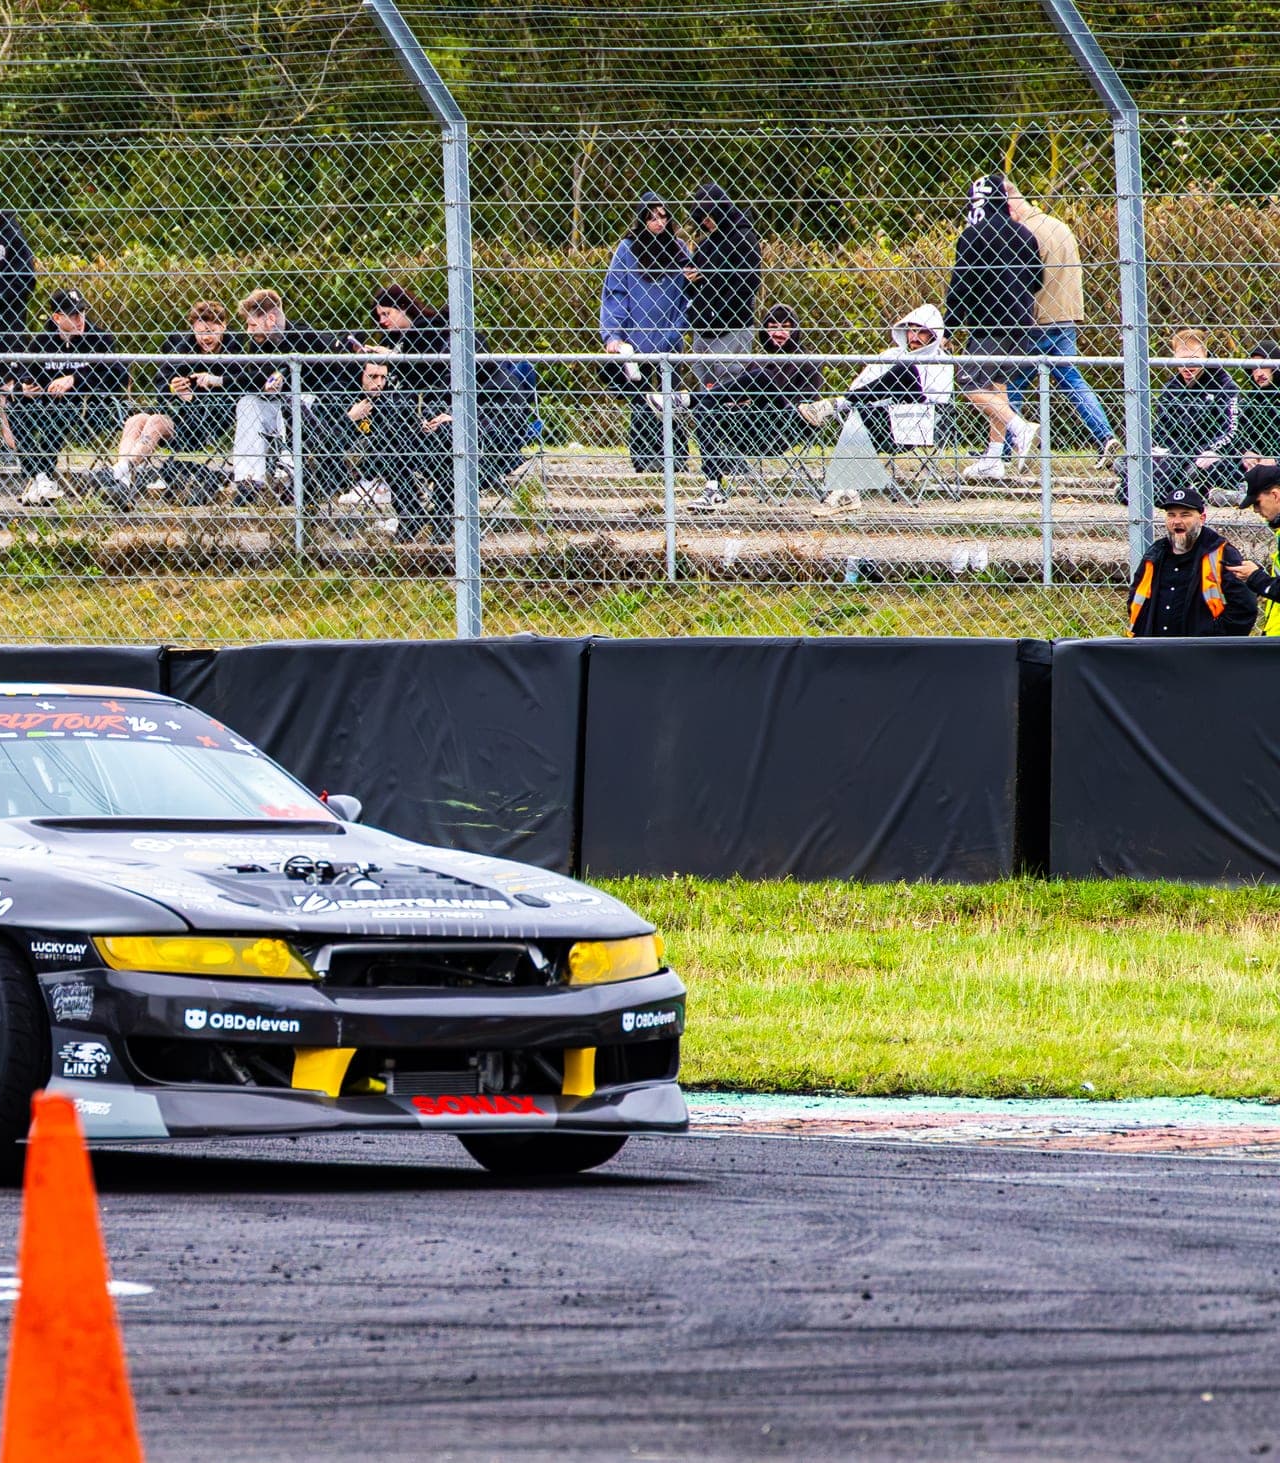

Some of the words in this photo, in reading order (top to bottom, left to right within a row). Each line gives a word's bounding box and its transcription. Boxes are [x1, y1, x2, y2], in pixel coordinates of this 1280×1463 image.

[46, 712, 128, 733] TOUR
[209, 1012, 300, 1033] OBDeleven
[635, 1010, 676, 1028] OBDeleven
[410, 1093, 547, 1116] SONAX
